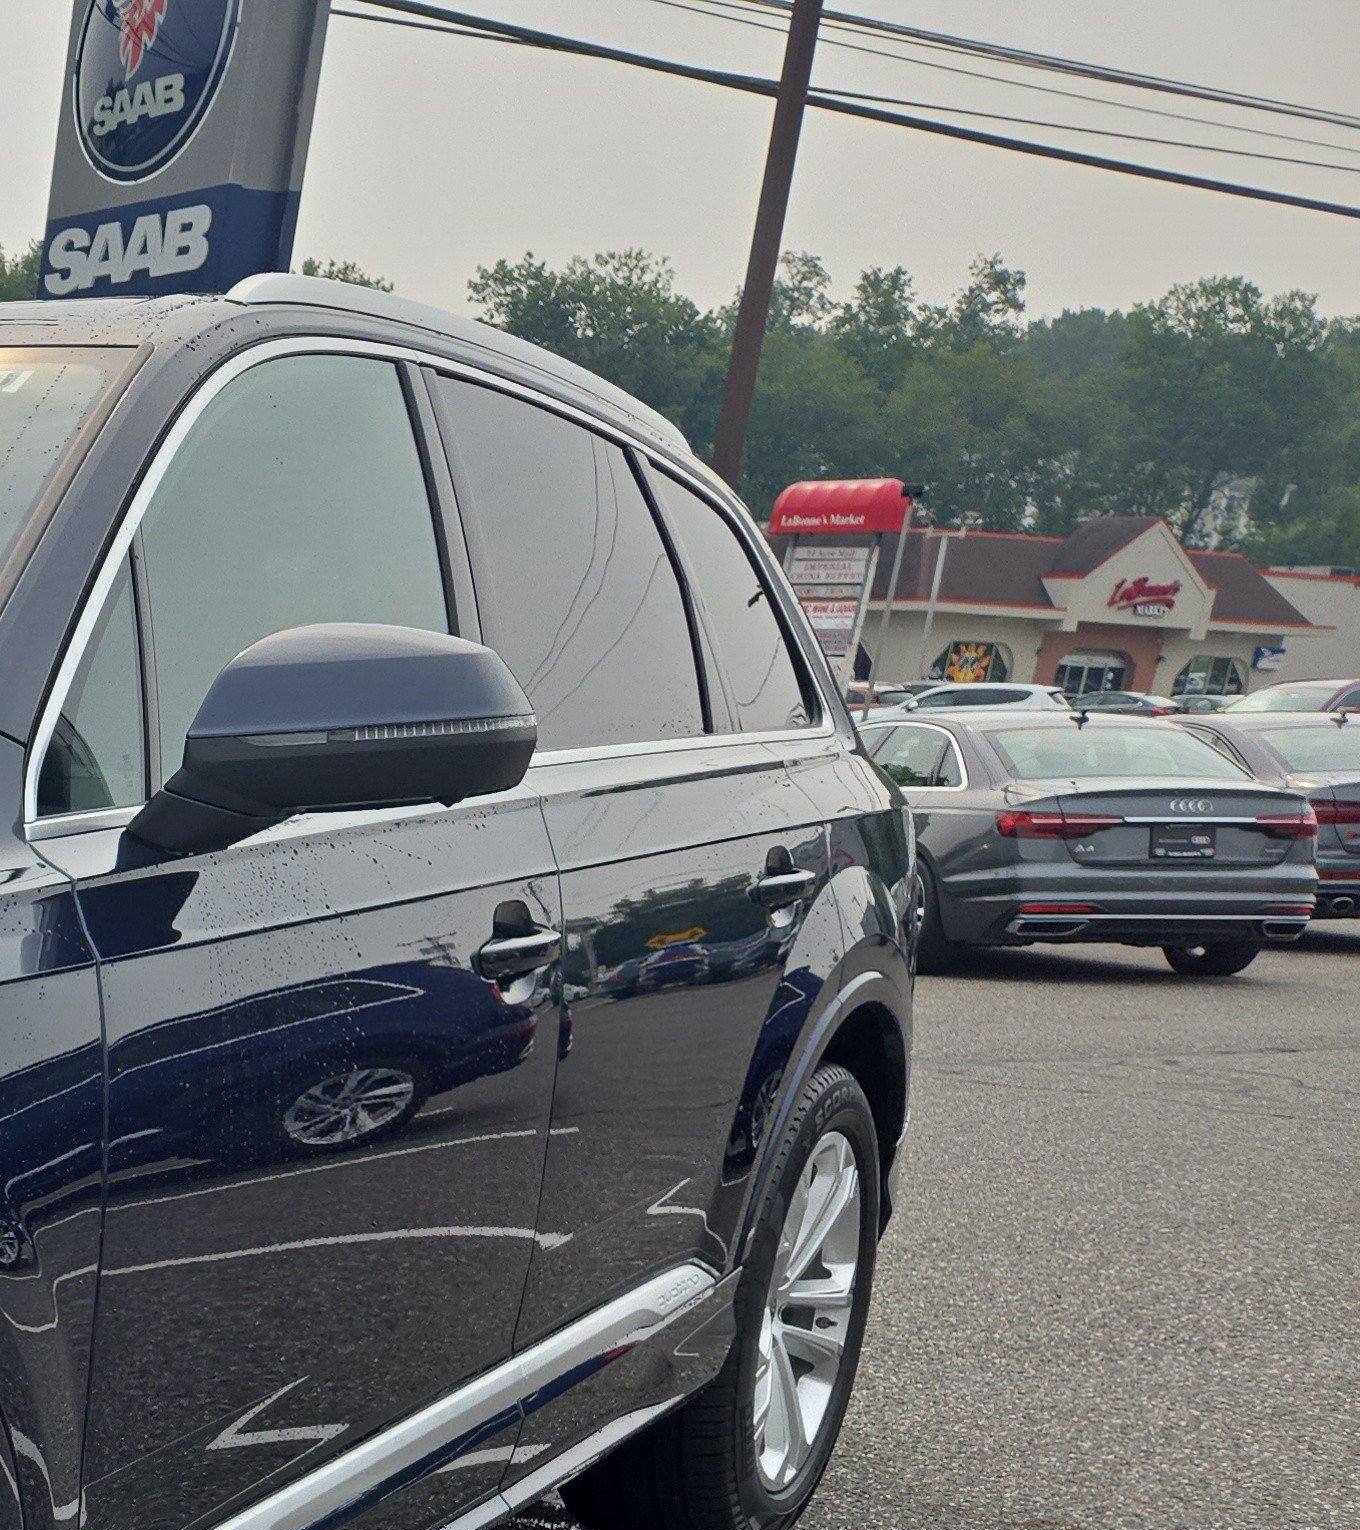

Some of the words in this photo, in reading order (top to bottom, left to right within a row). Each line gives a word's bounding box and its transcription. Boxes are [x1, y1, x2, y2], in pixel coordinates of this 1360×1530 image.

[92, 73, 185, 137] SAAB
[44, 204, 212, 296] SAAB
[829, 513, 865, 525] Market
